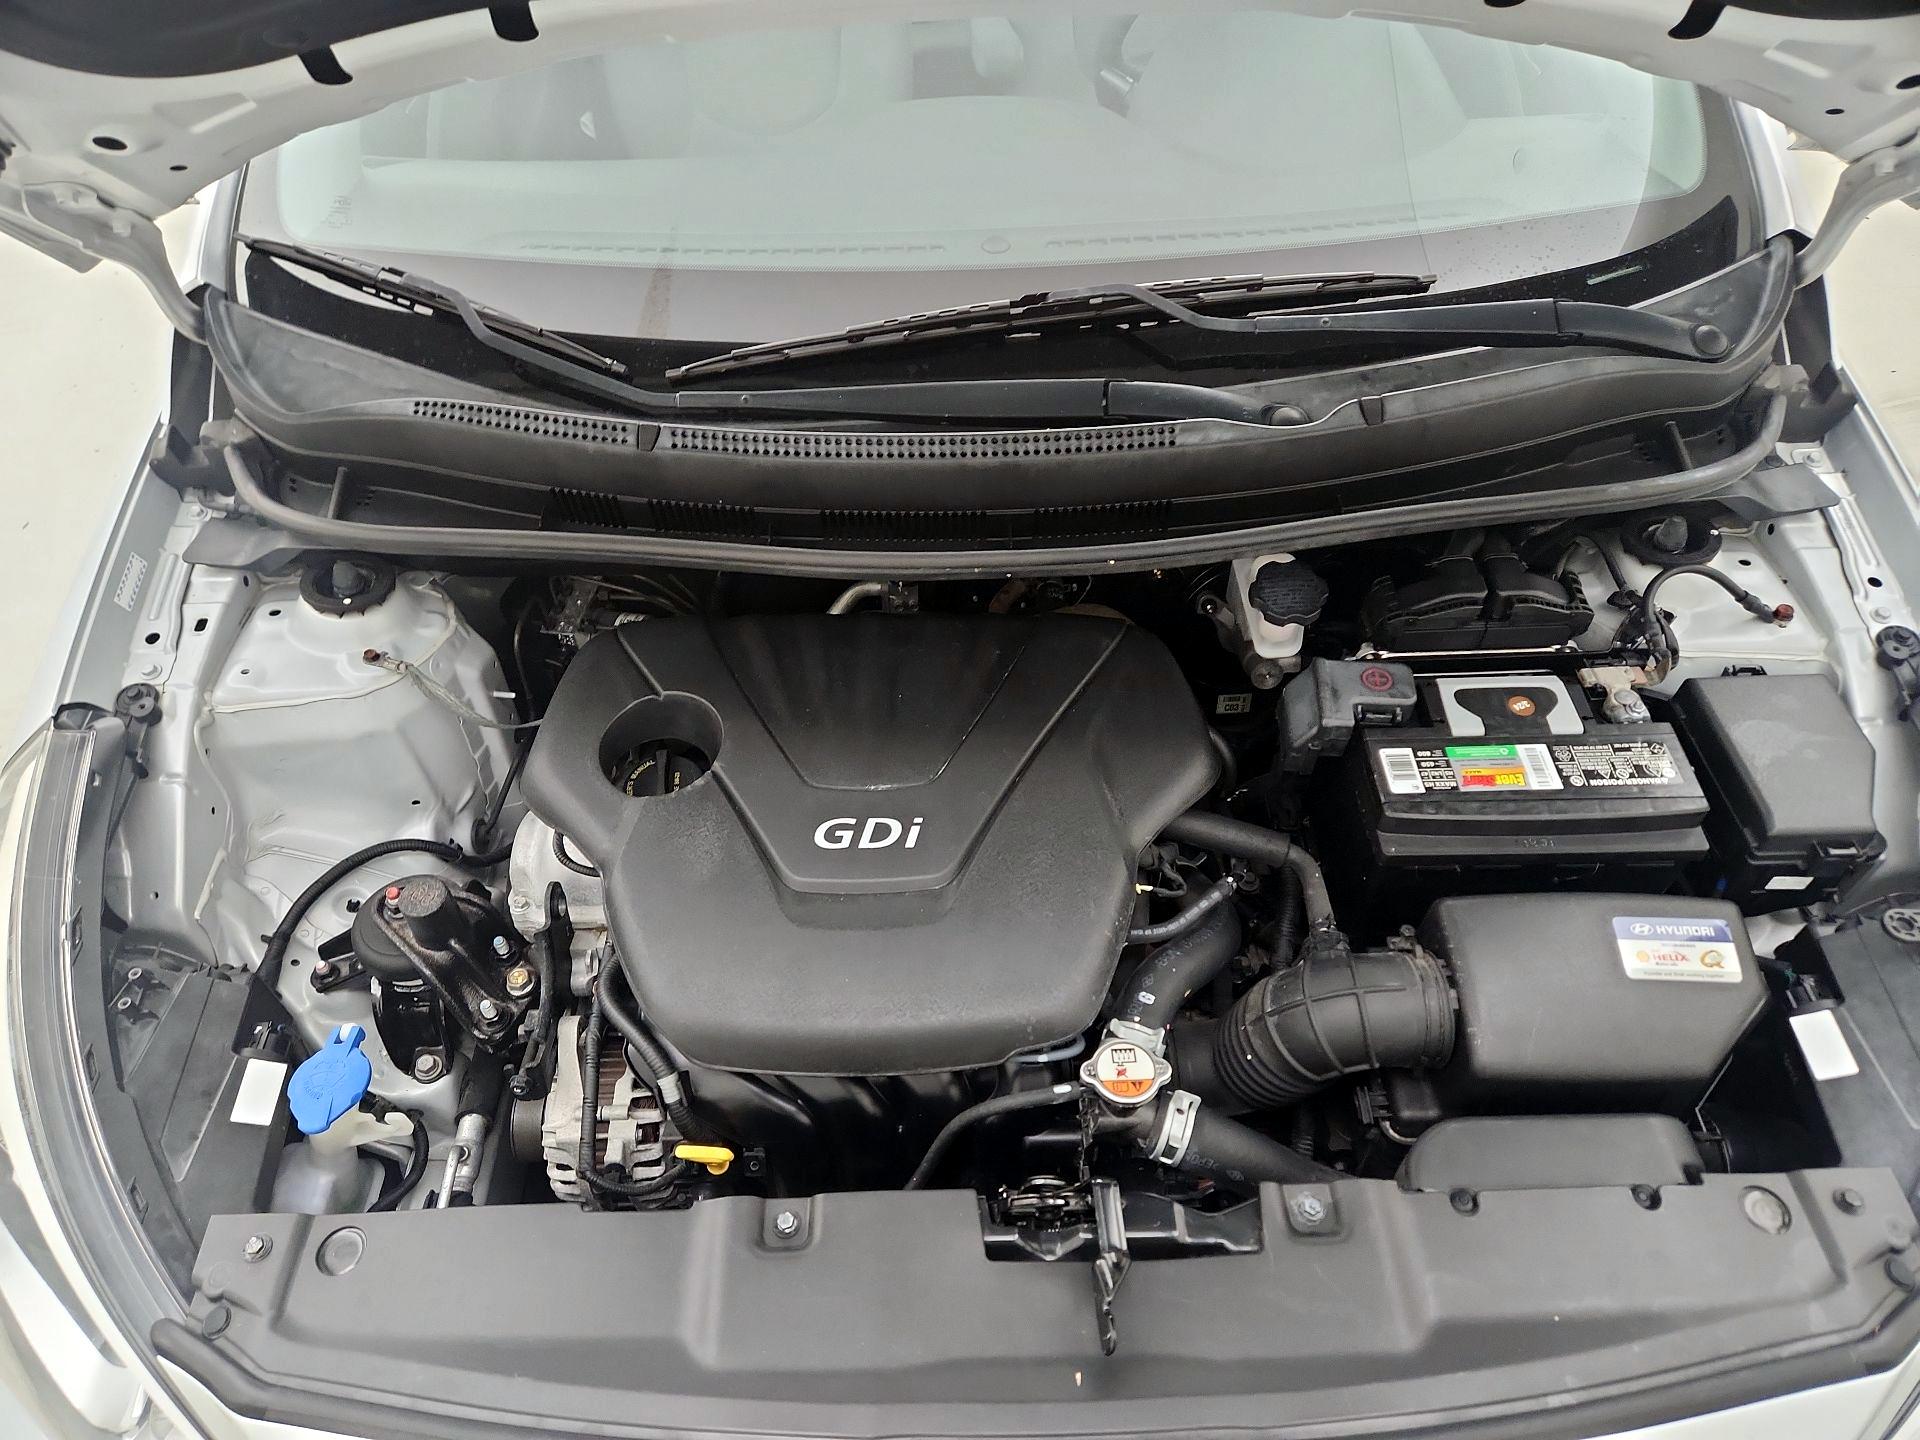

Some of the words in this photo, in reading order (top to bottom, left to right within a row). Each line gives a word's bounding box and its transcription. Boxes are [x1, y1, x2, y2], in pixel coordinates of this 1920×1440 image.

[1462, 773, 1526, 787] EverStart
[814, 817, 924, 849] GDi
[1656, 925, 1715, 937] HYUNDAI
[1653, 952, 1690, 962] HELIX
